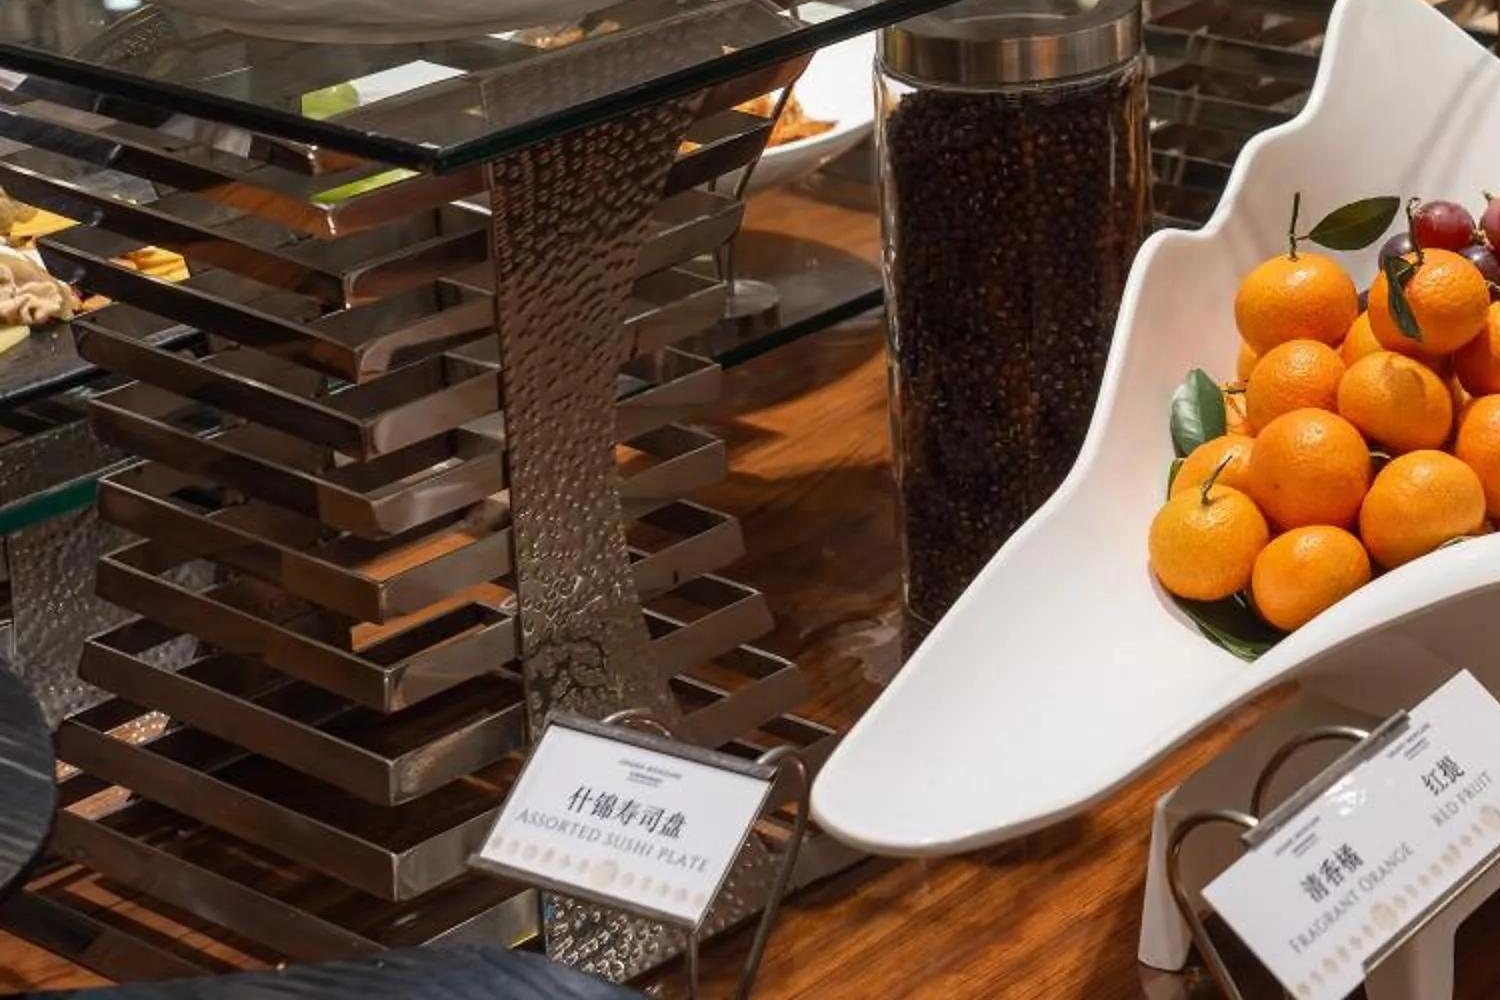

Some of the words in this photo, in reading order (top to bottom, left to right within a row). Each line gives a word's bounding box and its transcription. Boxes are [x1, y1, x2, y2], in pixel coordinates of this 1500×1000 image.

[567, 786, 688, 839] 什锦寿司盘
[1430, 800, 1459, 827] RED
[1456, 770, 1493, 805] FRUIT
[514, 808, 601, 843] ASSORTED
[605, 832, 653, 857] SUSHI
[657, 848, 710, 873] PLATE
[1288, 885, 1362, 954] FRAGRANT
[1359, 842, 1415, 893] ORANGE
